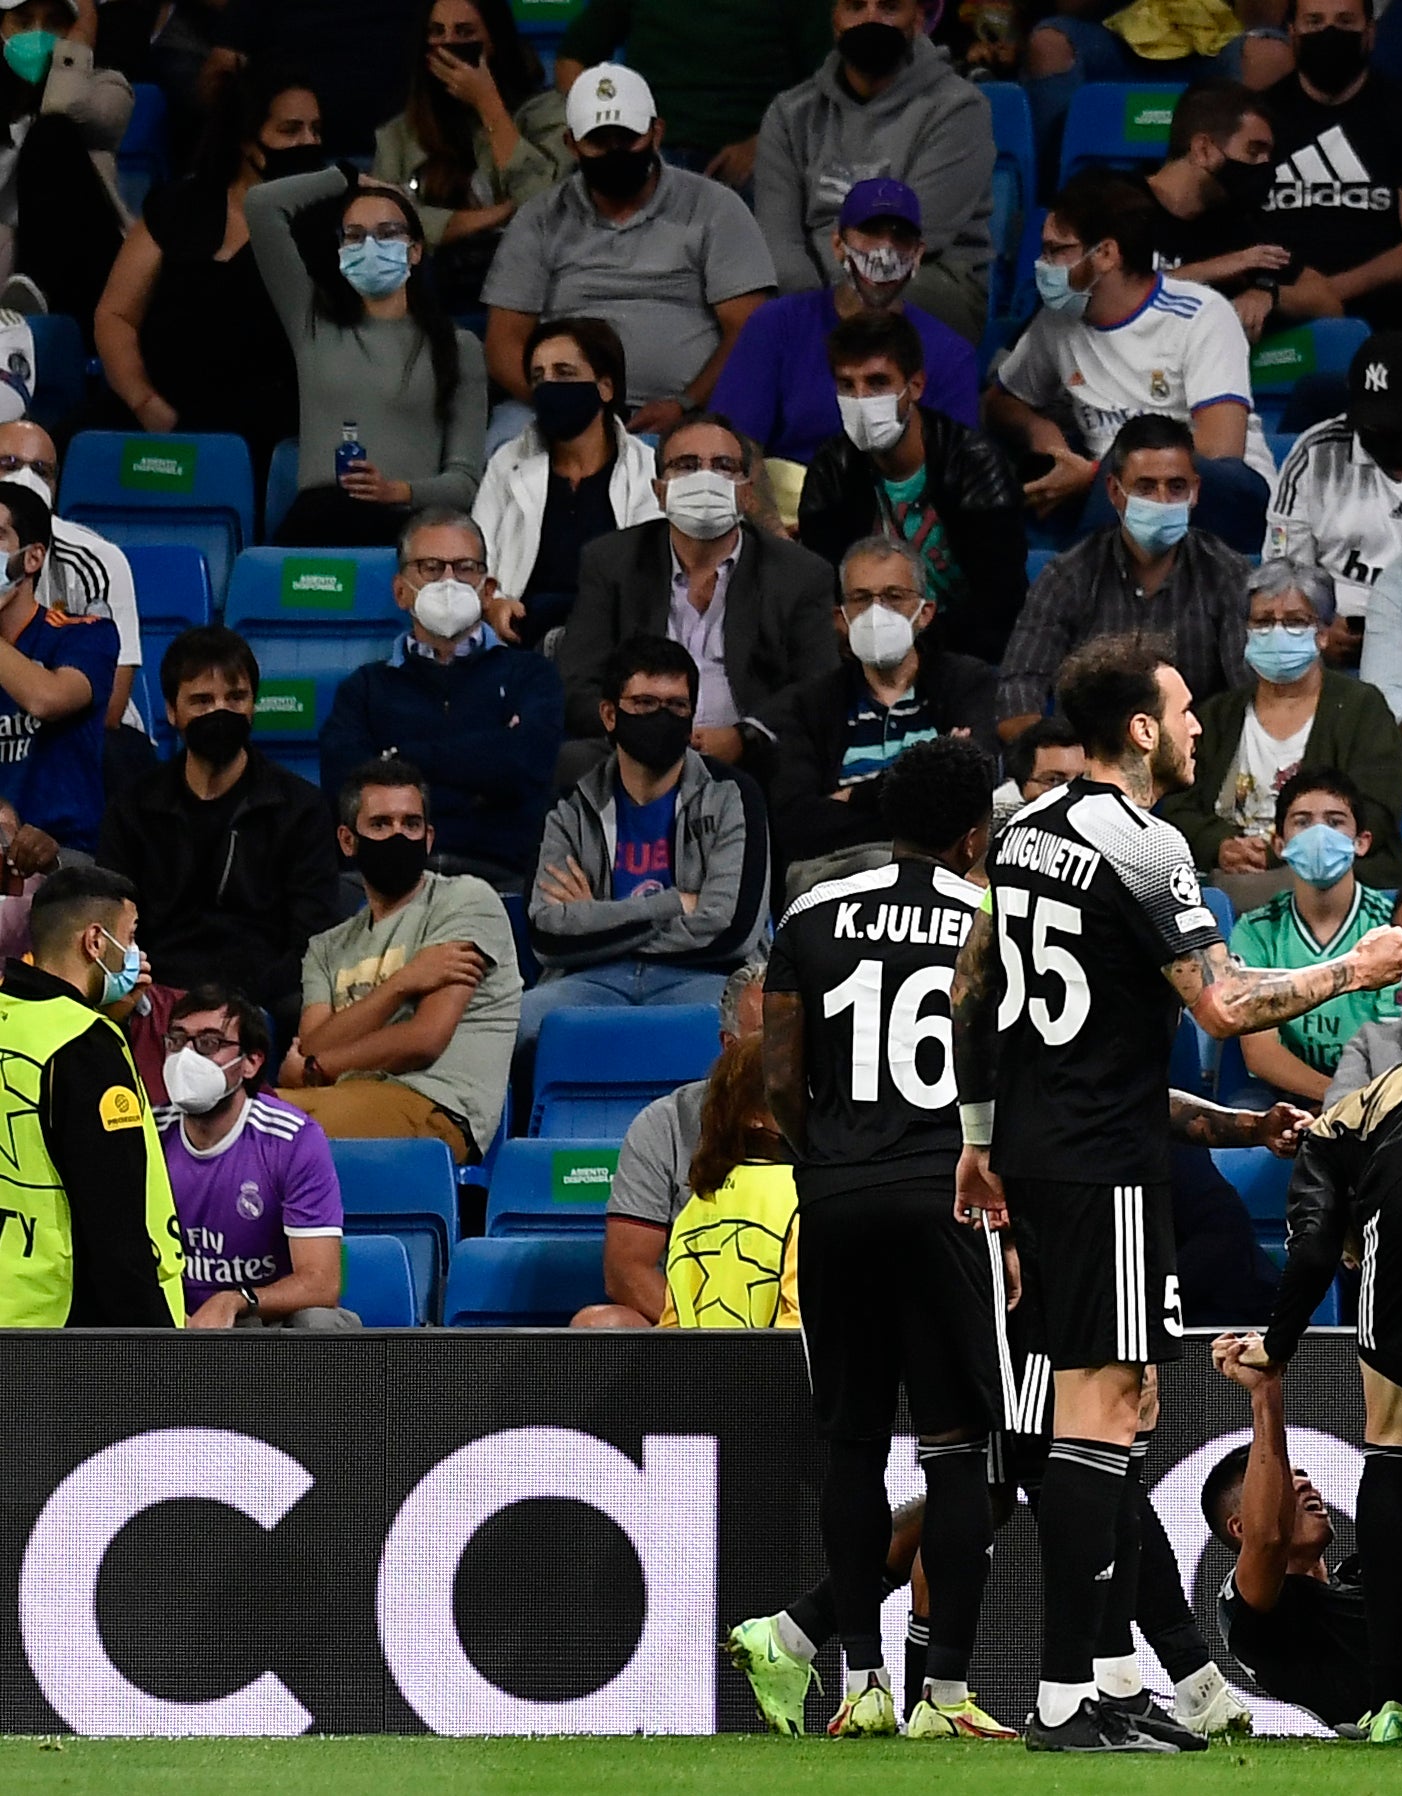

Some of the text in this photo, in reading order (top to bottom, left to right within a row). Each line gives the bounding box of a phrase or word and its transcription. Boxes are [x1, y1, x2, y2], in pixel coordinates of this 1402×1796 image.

[823, 959, 959, 1110] 16
[1303, 1013, 1341, 1037] Fly
[571, 1168, 609, 1177] ASIENTO
[187, 1227, 224, 1255] Fly
